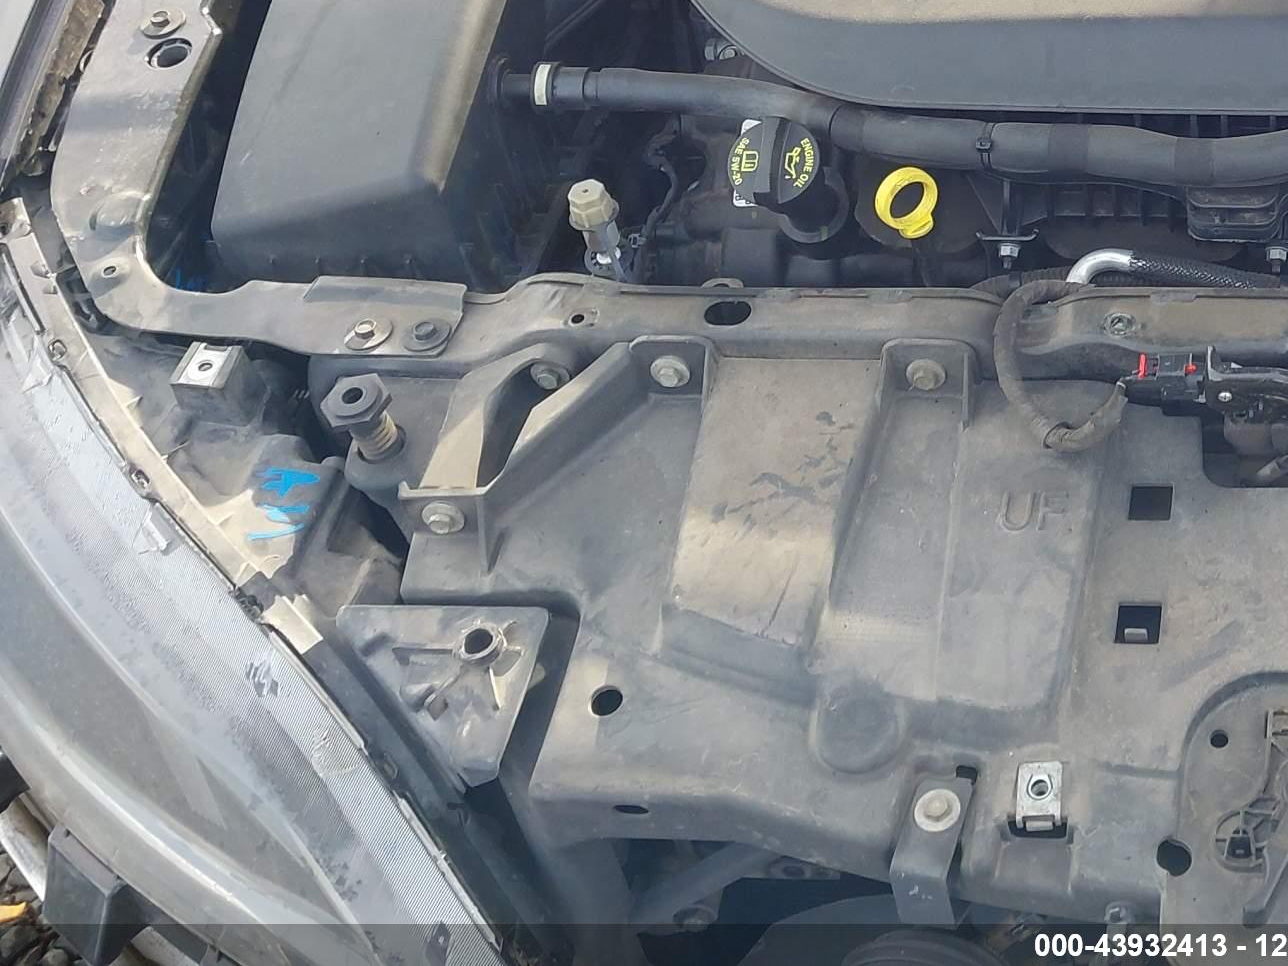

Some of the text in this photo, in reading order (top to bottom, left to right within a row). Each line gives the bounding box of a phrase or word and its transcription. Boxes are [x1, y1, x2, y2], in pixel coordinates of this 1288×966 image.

[730, 137, 750, 186] SAE 5W-20
[792, 137, 815, 188] ENGINE OIL
